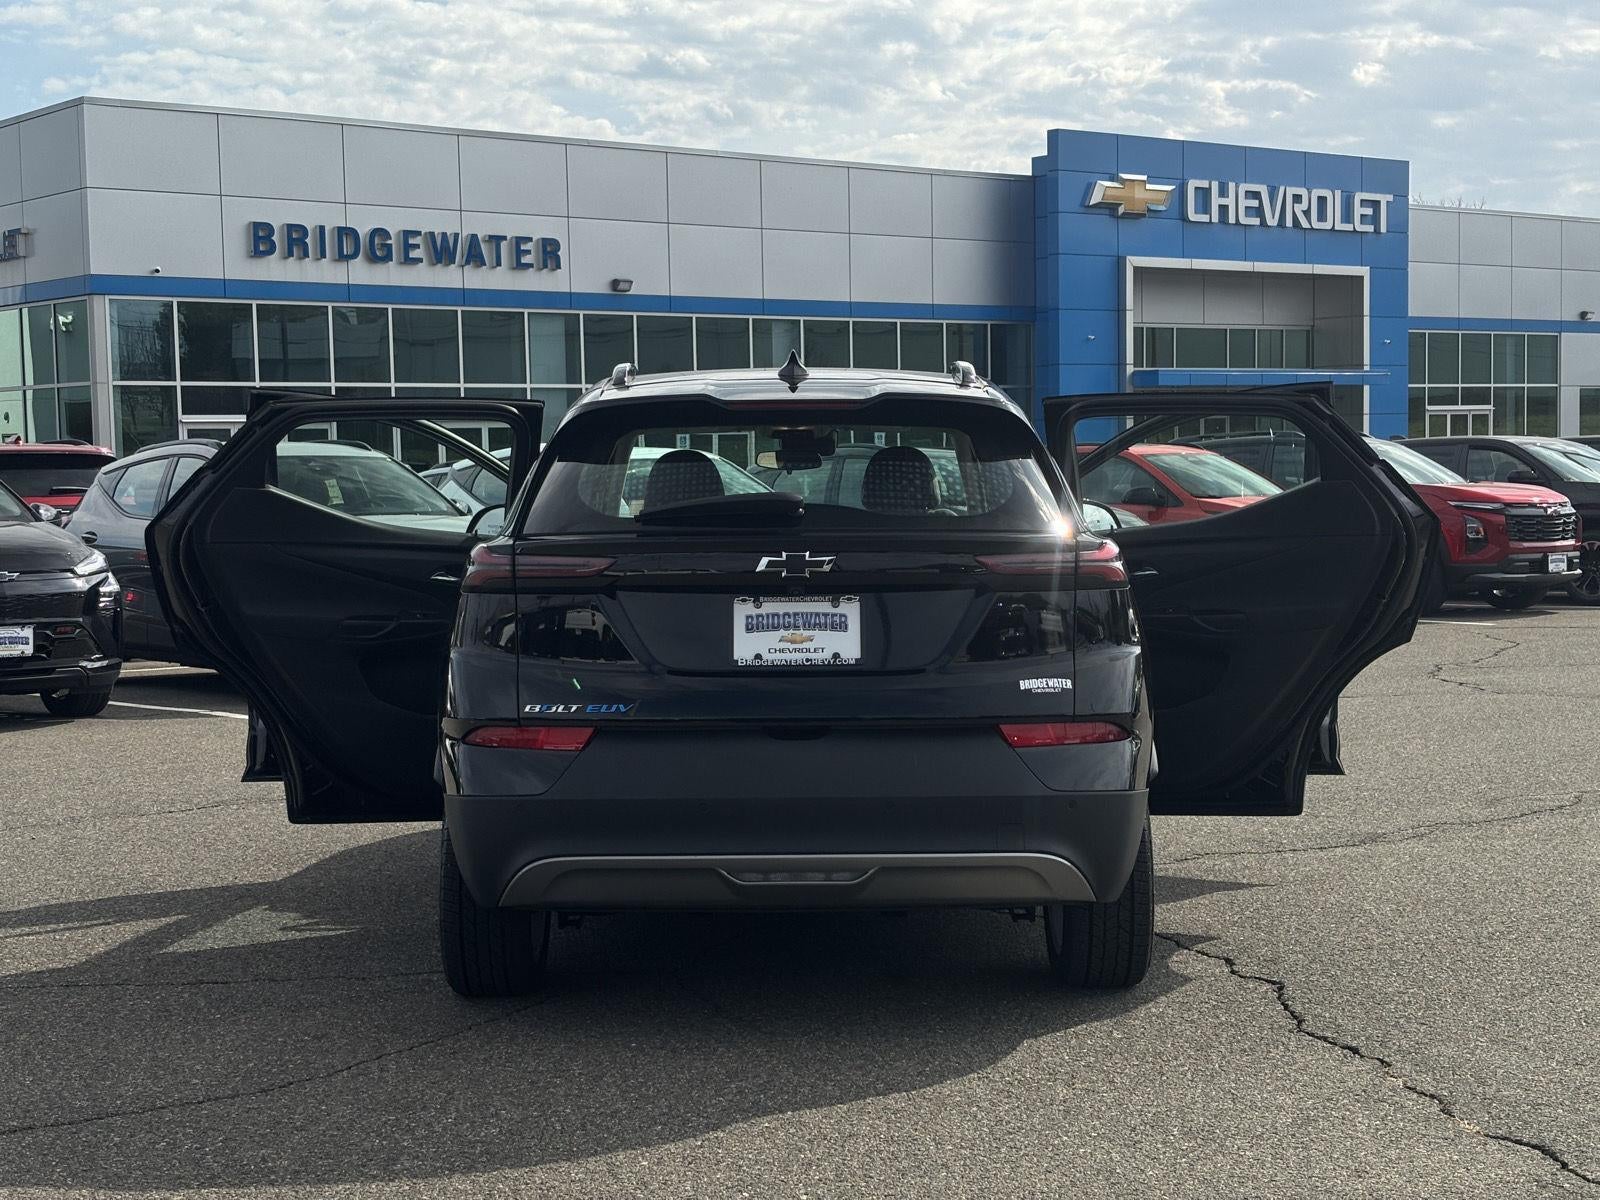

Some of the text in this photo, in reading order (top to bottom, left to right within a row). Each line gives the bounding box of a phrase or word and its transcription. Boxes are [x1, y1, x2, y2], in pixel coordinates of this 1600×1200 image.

[1186, 179, 1394, 234] CHEVROLET
[249, 221, 563, 272] BRIDGEWATER
[744, 612, 849, 633] BRIDGEWATER
[1019, 678, 1073, 690] BRIDGEWATER
[523, 703, 635, 713] BOLT EUV
